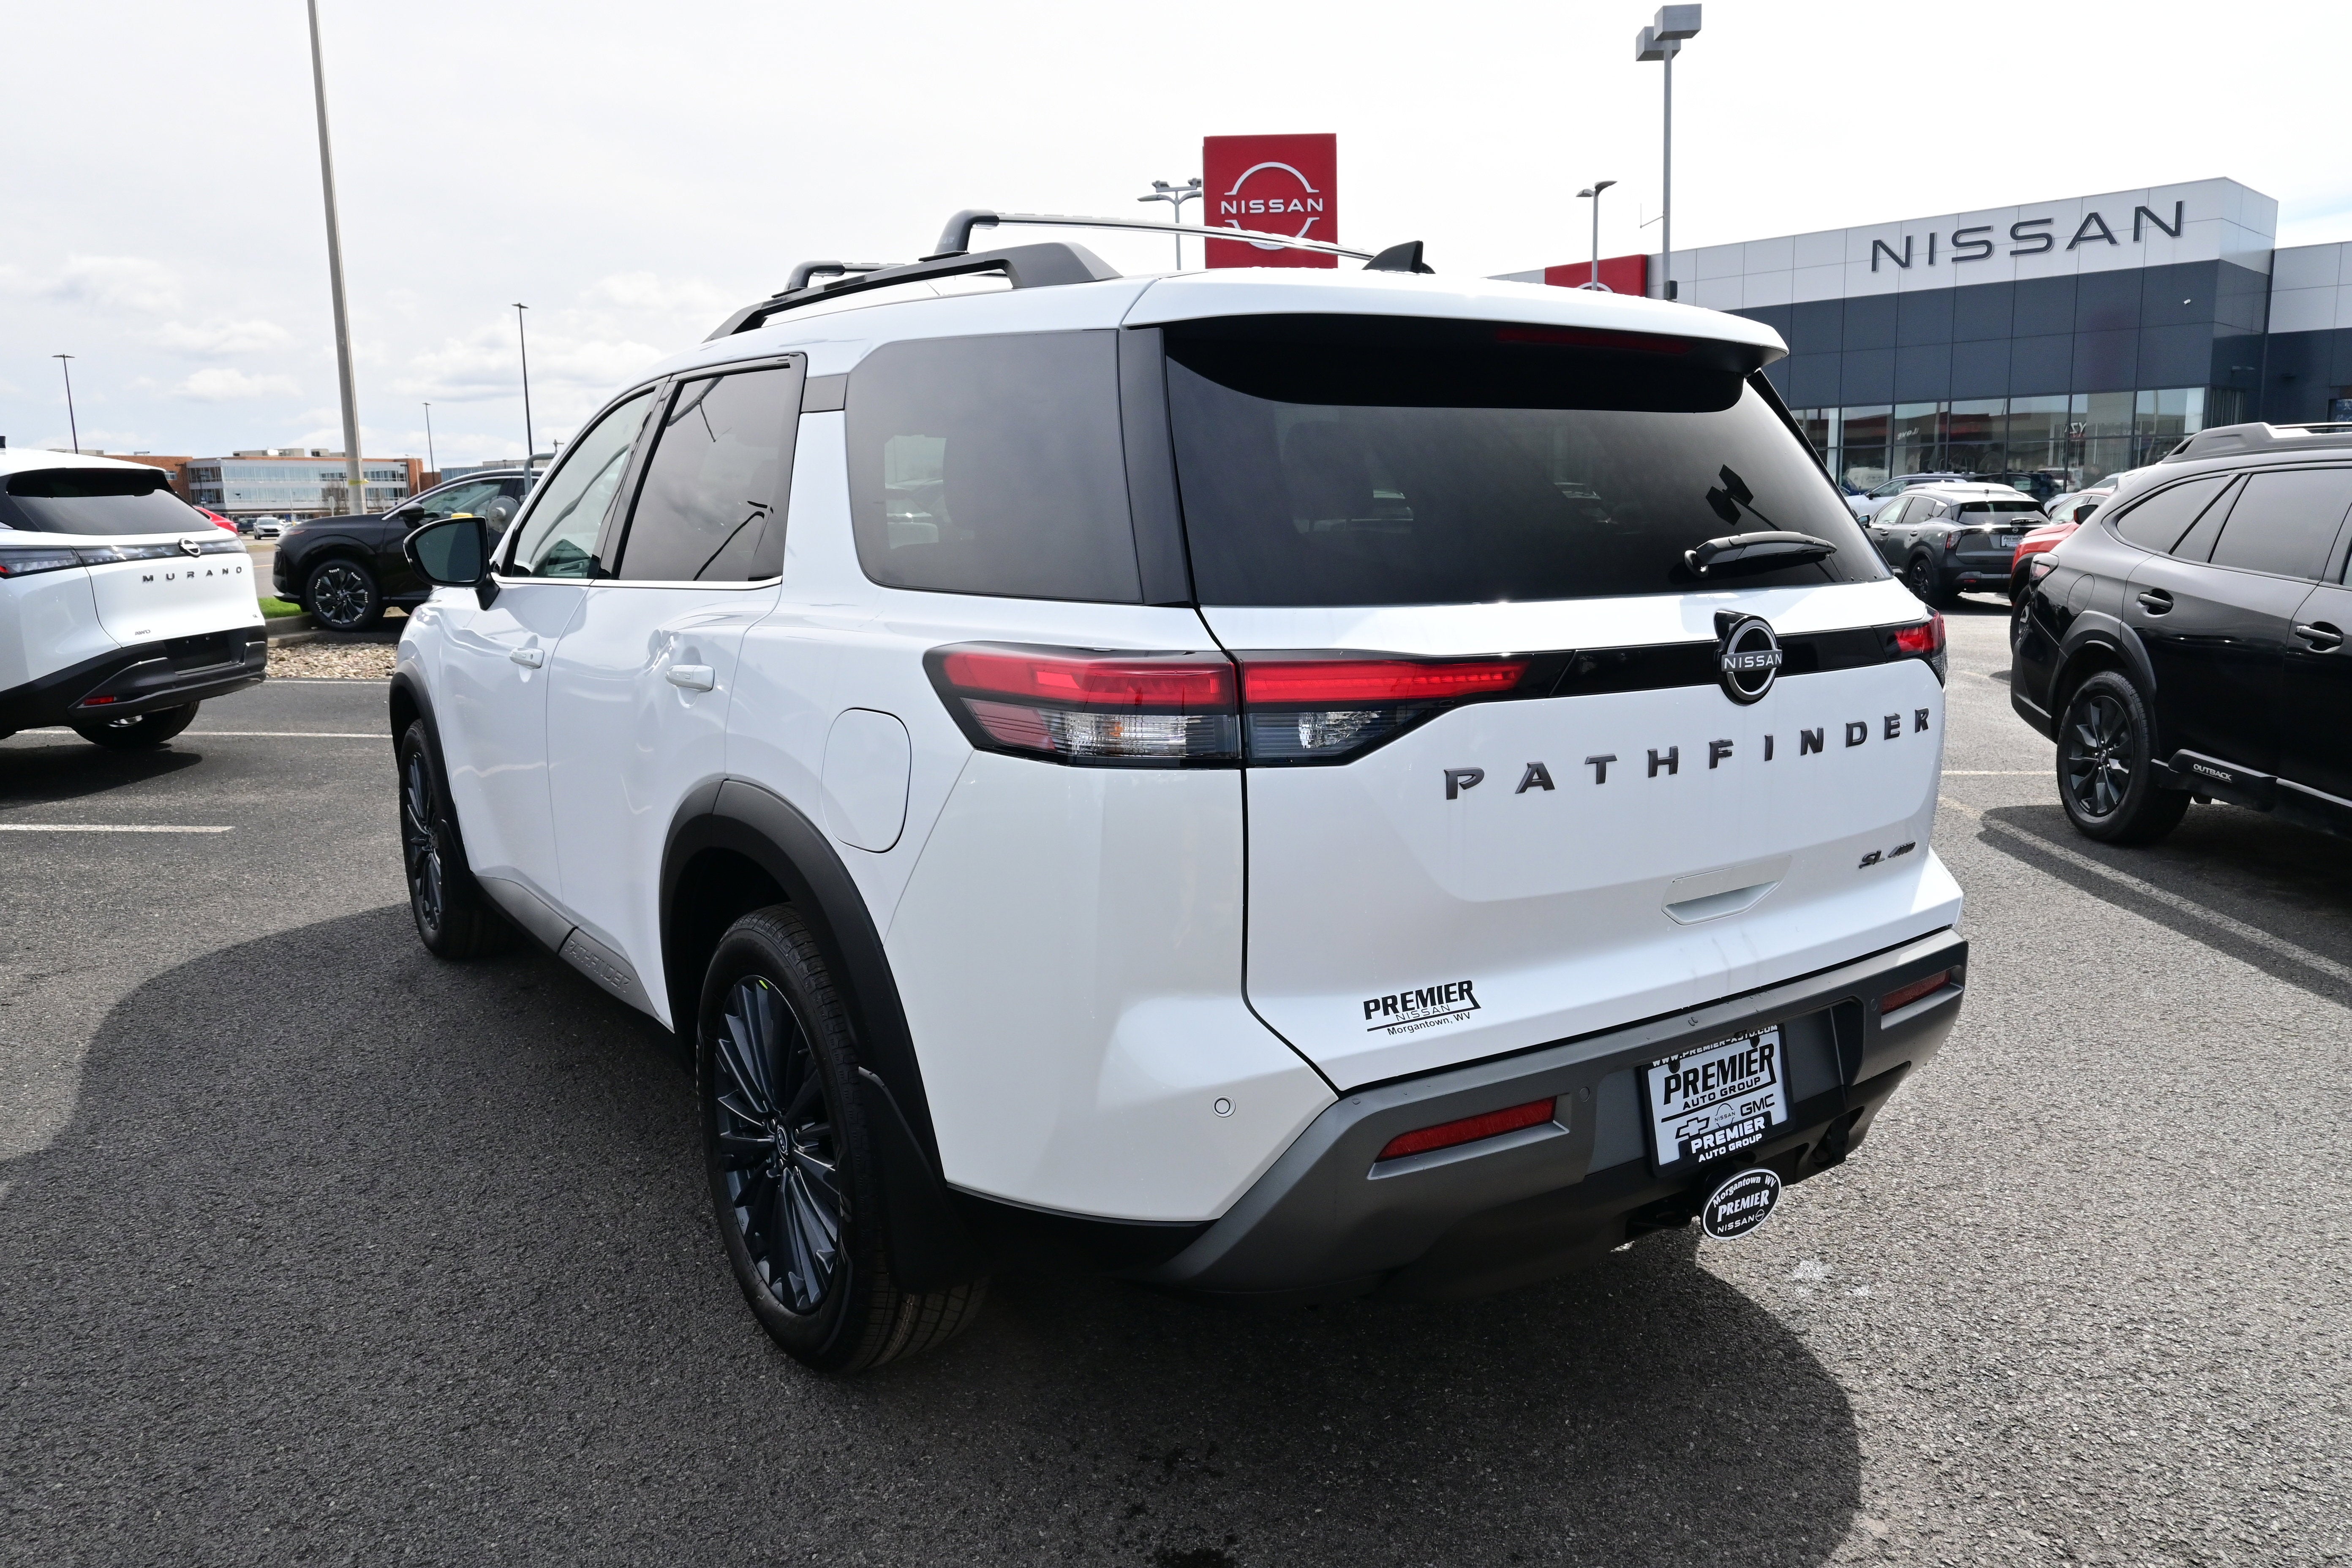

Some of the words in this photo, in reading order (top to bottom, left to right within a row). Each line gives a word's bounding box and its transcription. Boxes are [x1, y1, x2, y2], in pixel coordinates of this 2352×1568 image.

[1221, 198, 1323, 215] NISSAN
[1871, 200, 2184, 272] NISSAN
[142, 566, 242, 583] MURANO
[1724, 653, 1782, 669] NISSAN
[1443, 707, 1929, 800] PATHFINDER
[2193, 764, 2232, 781] OUTBACK
[1859, 849, 1886, 869] SL
[565, 939, 632, 993] PATHFINDER
[1363, 980, 1480, 1020] PREMIER
[1396, 1004, 1451, 1021] NISSAN
[1387, 1017, 1453, 1036] Morgantown,
[1453, 1012, 1471, 1022] WV
[1663, 1043, 1776, 1105] PREMIER
[1682, 1092, 1716, 1111] AUTO
[1720, 1076, 1761, 1097] GROUP
[1740, 1093, 1775, 1116] GMC
[1715, 1111, 1736, 1122] NISSAN
[1690, 1116, 1765, 1154] PREMIER
[1698, 1146, 1726, 1162] AUTO
[1729, 1133, 1762, 1152] GROUP
[1712, 1176, 1761, 1208] Morgantown
[1764, 1175, 1777, 1188] WV
[1717, 1189, 1769, 1222] PREMIER
[1717, 1214, 1755, 1234] NISSAN
